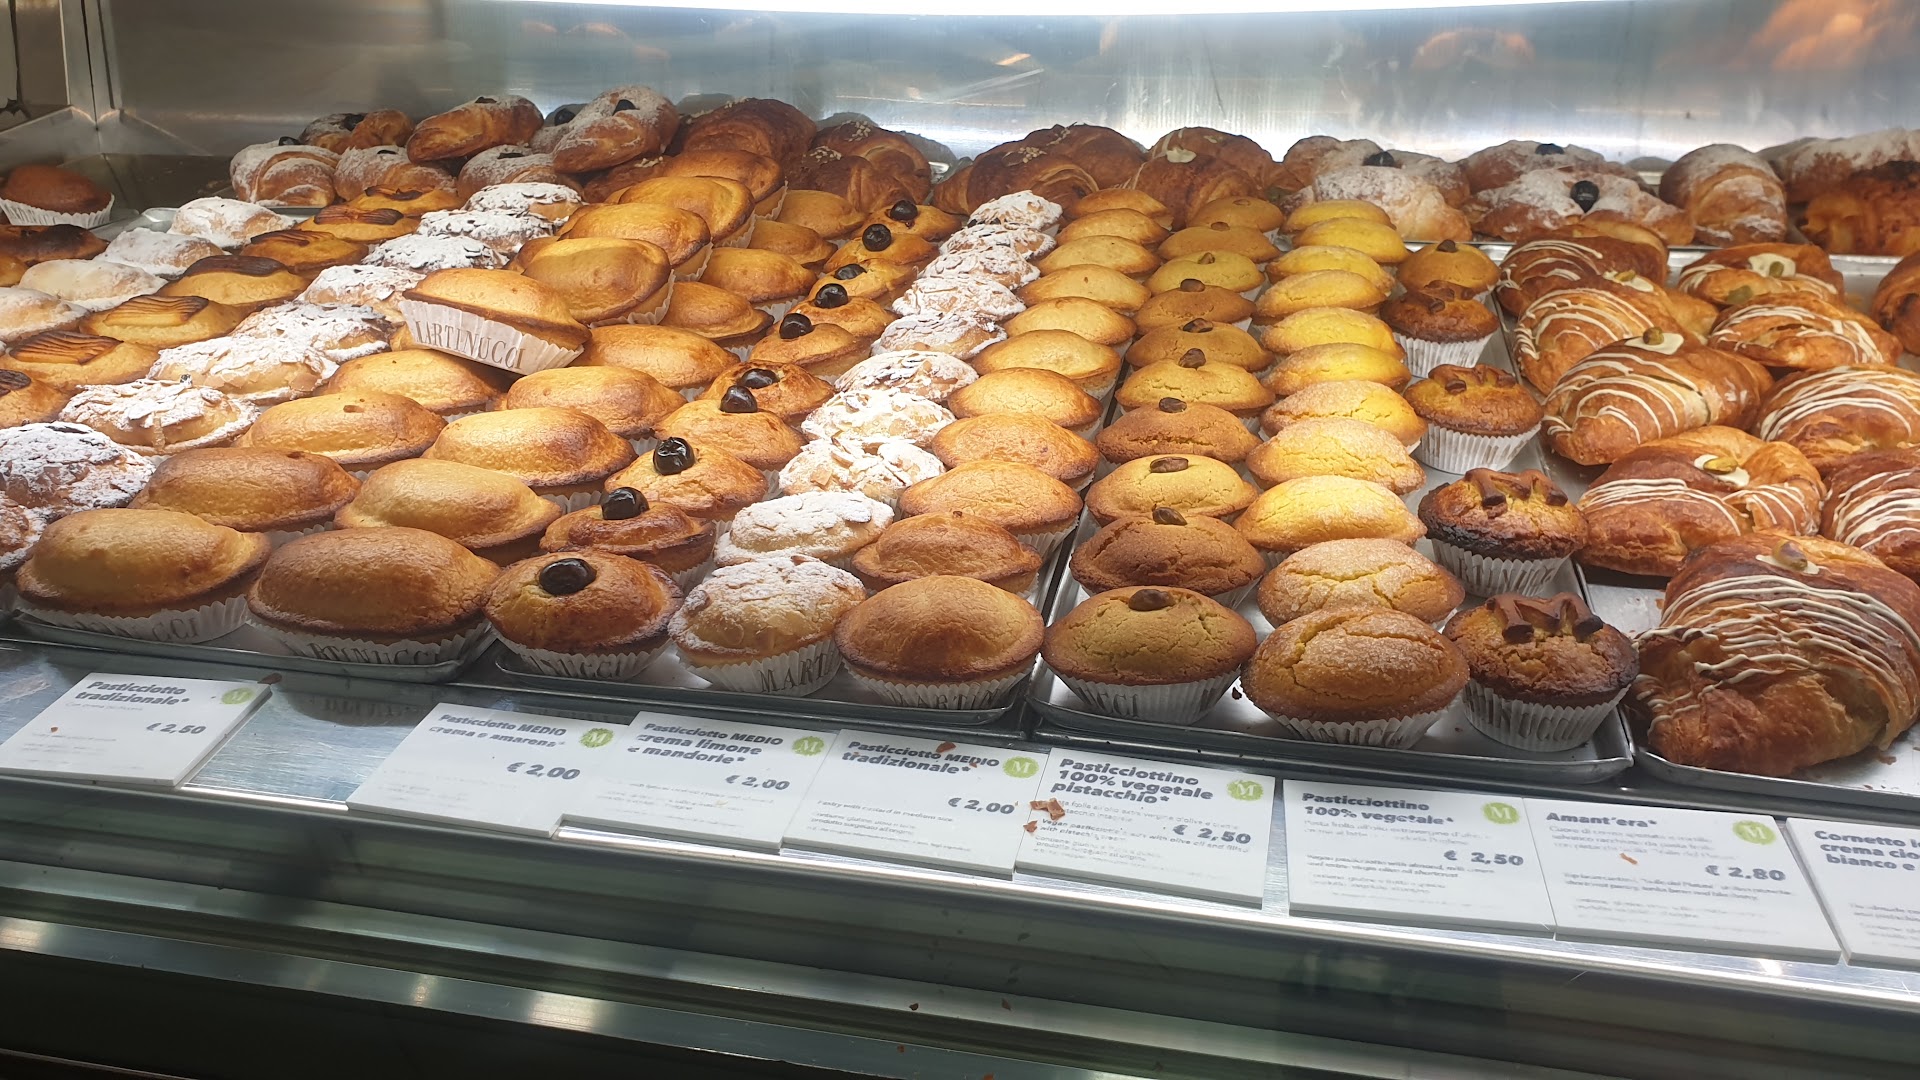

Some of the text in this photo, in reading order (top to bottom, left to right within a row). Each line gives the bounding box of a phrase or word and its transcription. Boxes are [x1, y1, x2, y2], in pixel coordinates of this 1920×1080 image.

[87, 681, 187, 695] Pasticciotto
[161, 723, 207, 735] 2,50
[428, 726, 474, 738] crema
[438, 714, 567, 737] Pasticciotto MEDIO
[644, 723, 784, 746] Pasticciotto MEDIO
[637, 734, 762, 755] crema limone
[848, 741, 1000, 767] Pasticciotto MEDIO
[507, 762, 581, 780] € 2,00
[1059, 758, 1199, 786] Pasticciottino
[725, 774, 791, 790] € 2,00
[1058, 770, 1214, 800] 100% vegetale
[948, 797, 1015, 814] € 2,00
[1302, 792, 1430, 812] Pasticciottino
[1304, 806, 1357, 819] 100%
[1172, 825, 1251, 844] € 2,50
[1814, 830, 1906, 847] Cornetto
[1443, 850, 1524, 866] € 2,50
[1820, 843, 1885, 857] crema
[1705, 865, 1720, 876] €
[1826, 853, 1915, 871] bianco e
